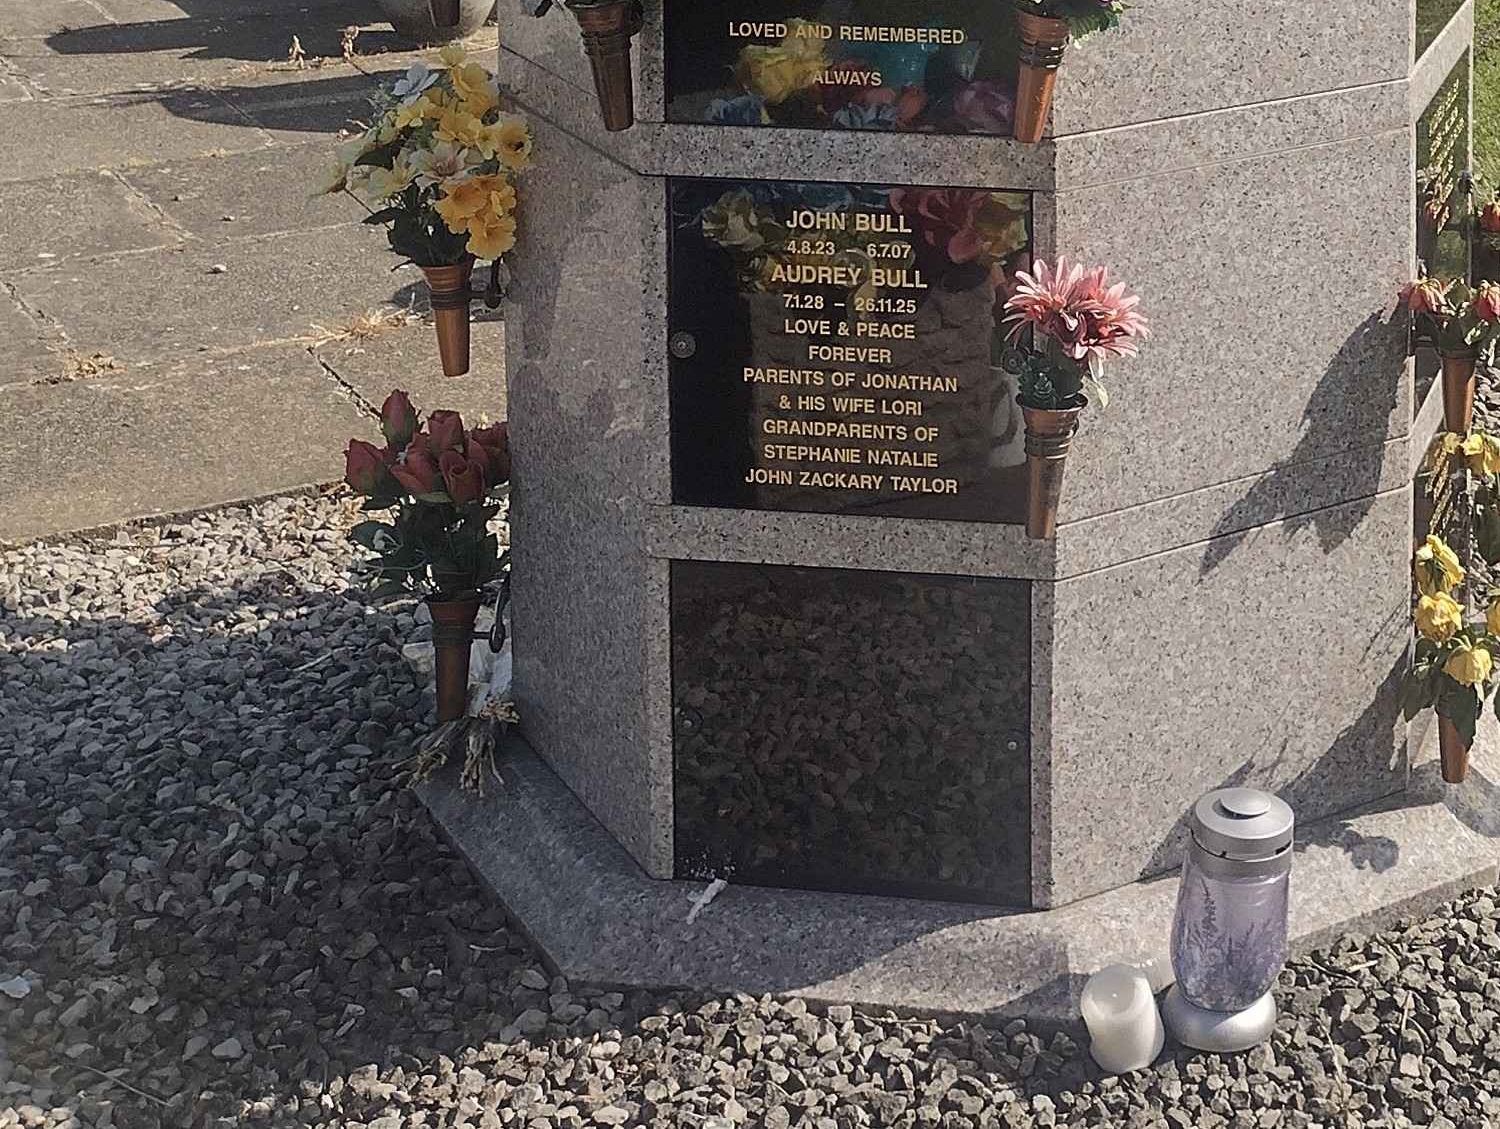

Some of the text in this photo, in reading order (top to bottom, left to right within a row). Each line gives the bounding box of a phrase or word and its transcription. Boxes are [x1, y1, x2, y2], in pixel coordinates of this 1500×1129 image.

[729, 21, 965, 45] LOVED AND REMEMBERED
[811, 70, 883, 87] ALWAYS
[785, 210, 913, 234] JOHN BULL
[786, 240, 836, 256] 4.8.23
[866, 242, 913, 259] 6.7.07
[770, 265, 929, 289] AUDREY BULL
[854, 297, 917, 314] 26.11.25
[784, 319, 916, 340] LOVE & PEACE
[807, 345, 892, 363] FOREVER
[743, 367, 959, 393] PARENTS OF JONATHAN
[778, 395, 923, 416] & HIS WIFE LORI
[762, 419, 939, 442] GRANDPARENTS OF
[763, 444, 939, 468] STEPHANIE NATALIE
[744, 468, 959, 494] JOHN ZACKARY TAYLOR
